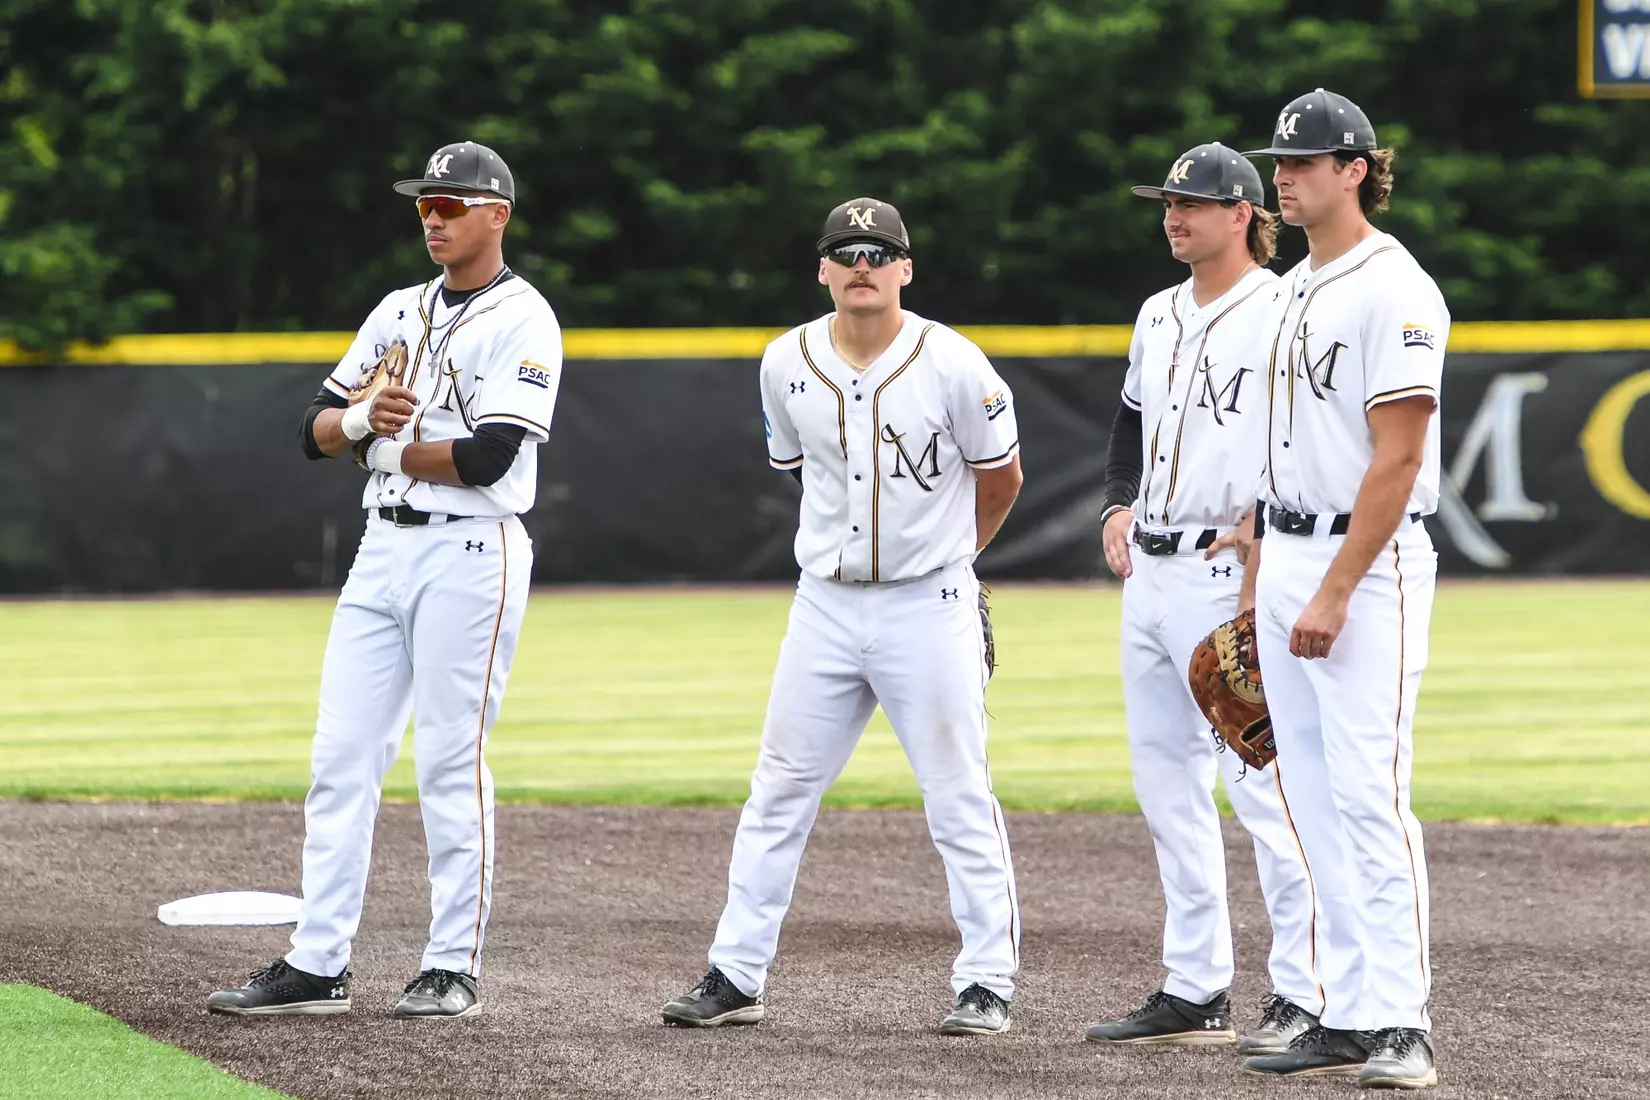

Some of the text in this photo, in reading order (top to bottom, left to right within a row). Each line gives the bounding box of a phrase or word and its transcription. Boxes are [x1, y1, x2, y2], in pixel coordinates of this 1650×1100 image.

[1277, 112, 1301, 140] M
[1169, 159, 1194, 184] M
[847, 206, 877, 231] M
[1403, 330, 1434, 345] PSAC
[1297, 321, 1348, 401] M
[518, 366, 550, 384] PSAC
[1197, 355, 1253, 426] M
[984, 393, 1006, 415] PSAC
[881, 423, 942, 491] M
